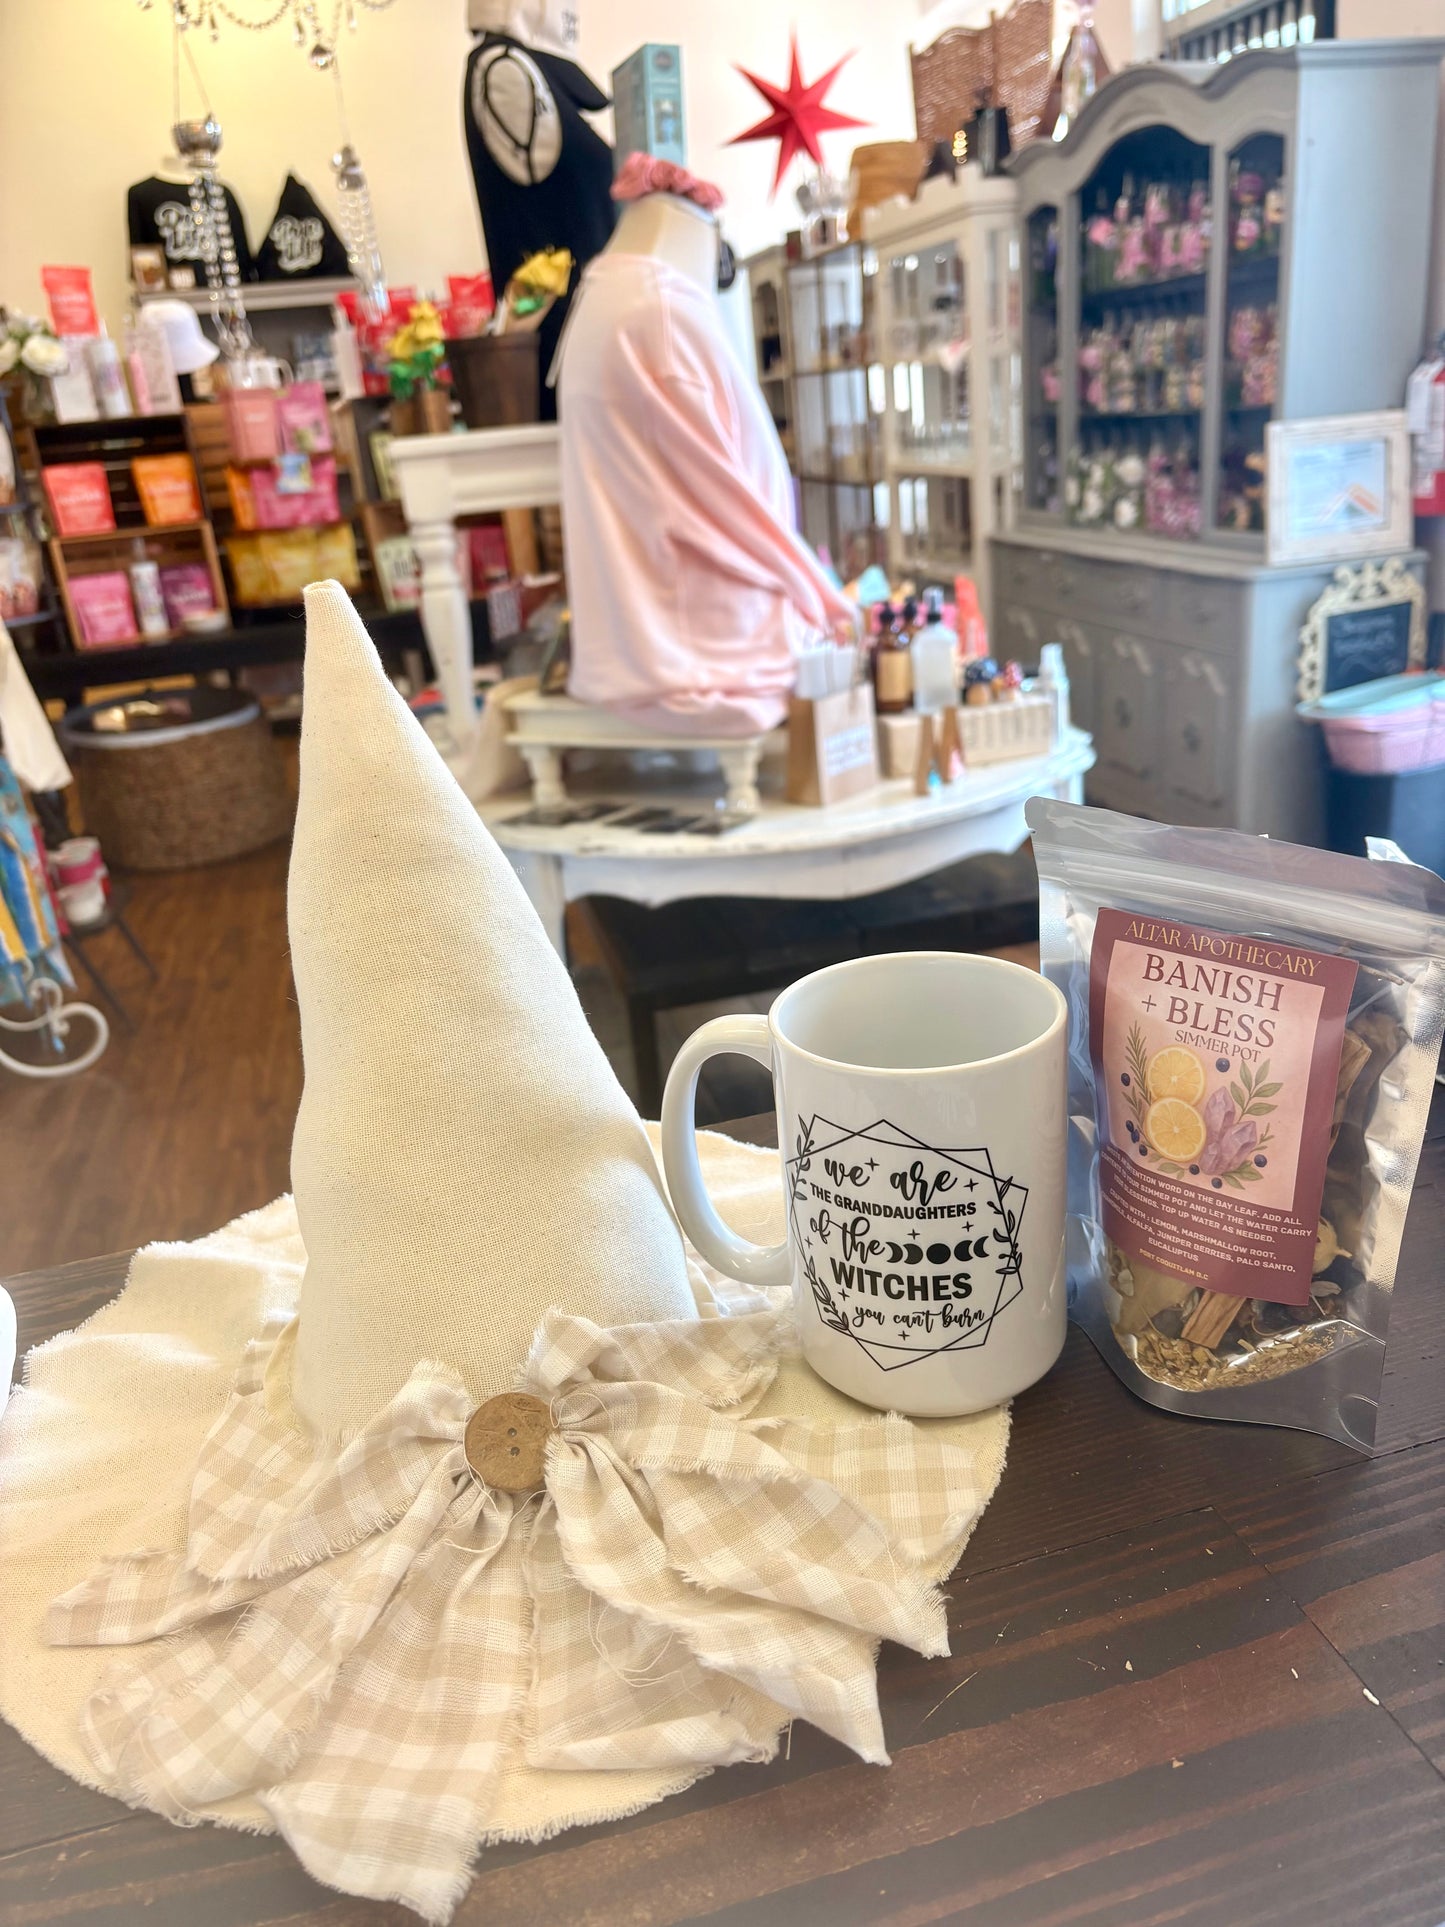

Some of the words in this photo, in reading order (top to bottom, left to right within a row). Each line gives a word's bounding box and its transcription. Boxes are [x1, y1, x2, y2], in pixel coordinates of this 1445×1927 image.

[1125, 920, 1181, 948] ALTAR
[1184, 934, 1321, 977] APOTHECARY
[1142, 953, 1284, 1012] BANISH
[1166, 995, 1276, 1048] BLESS
[1175, 1029, 1229, 1055] SIMMER
[1231, 1044, 1261, 1062] POT
[810, 1182, 832, 1204] THE
[834, 1194, 977, 1220] GRANDDAUGHTERS
[824, 1158, 870, 1187] we
[890, 1161, 957, 1206] are
[1158, 1180, 1182, 1194] WORD
[1183, 1189, 1195, 1198] ON
[1197, 1193, 1214, 1204] THE
[1234, 1205, 1260, 1218] LEAF.
[1262, 1213, 1282, 1222] ADD
[1283, 1217, 1302, 1225] ALL
[1129, 1204, 1146, 1218] WITH
[1181, 1227, 1248, 1254] MARSHMALLOW
[1140, 1183, 1170, 1201] SIMMER
[1171, 1196, 1188, 1207] POT
[1189, 1203, 1207, 1214] AND
[1209, 1208, 1225, 1219] LET
[1227, 1214, 1244, 1225] THE
[1246, 1220, 1279, 1233] WATER
[1280, 1227, 1313, 1237] CARRY
[1160, 1204, 1177, 1214] TOP
[1178, 1210, 1190, 1219] UP
[1191, 1214, 1220, 1229] WATER
[1222, 1224, 1234, 1234] AS
[1236, 1228, 1276, 1243] NEEDED.
[810, 1209, 831, 1244] of
[841, 1216, 885, 1264] the
[1156, 1230, 1192, 1249] JUNIPER
[1236, 1256, 1261, 1267] PALO
[830, 1257, 973, 1301] WITCHES
[1139, 1248, 1155, 1260] PORT
[1156, 1256, 1195, 1276] COQUITLAM
[852, 1306, 885, 1327] you
[941, 1303, 984, 1328] burn
